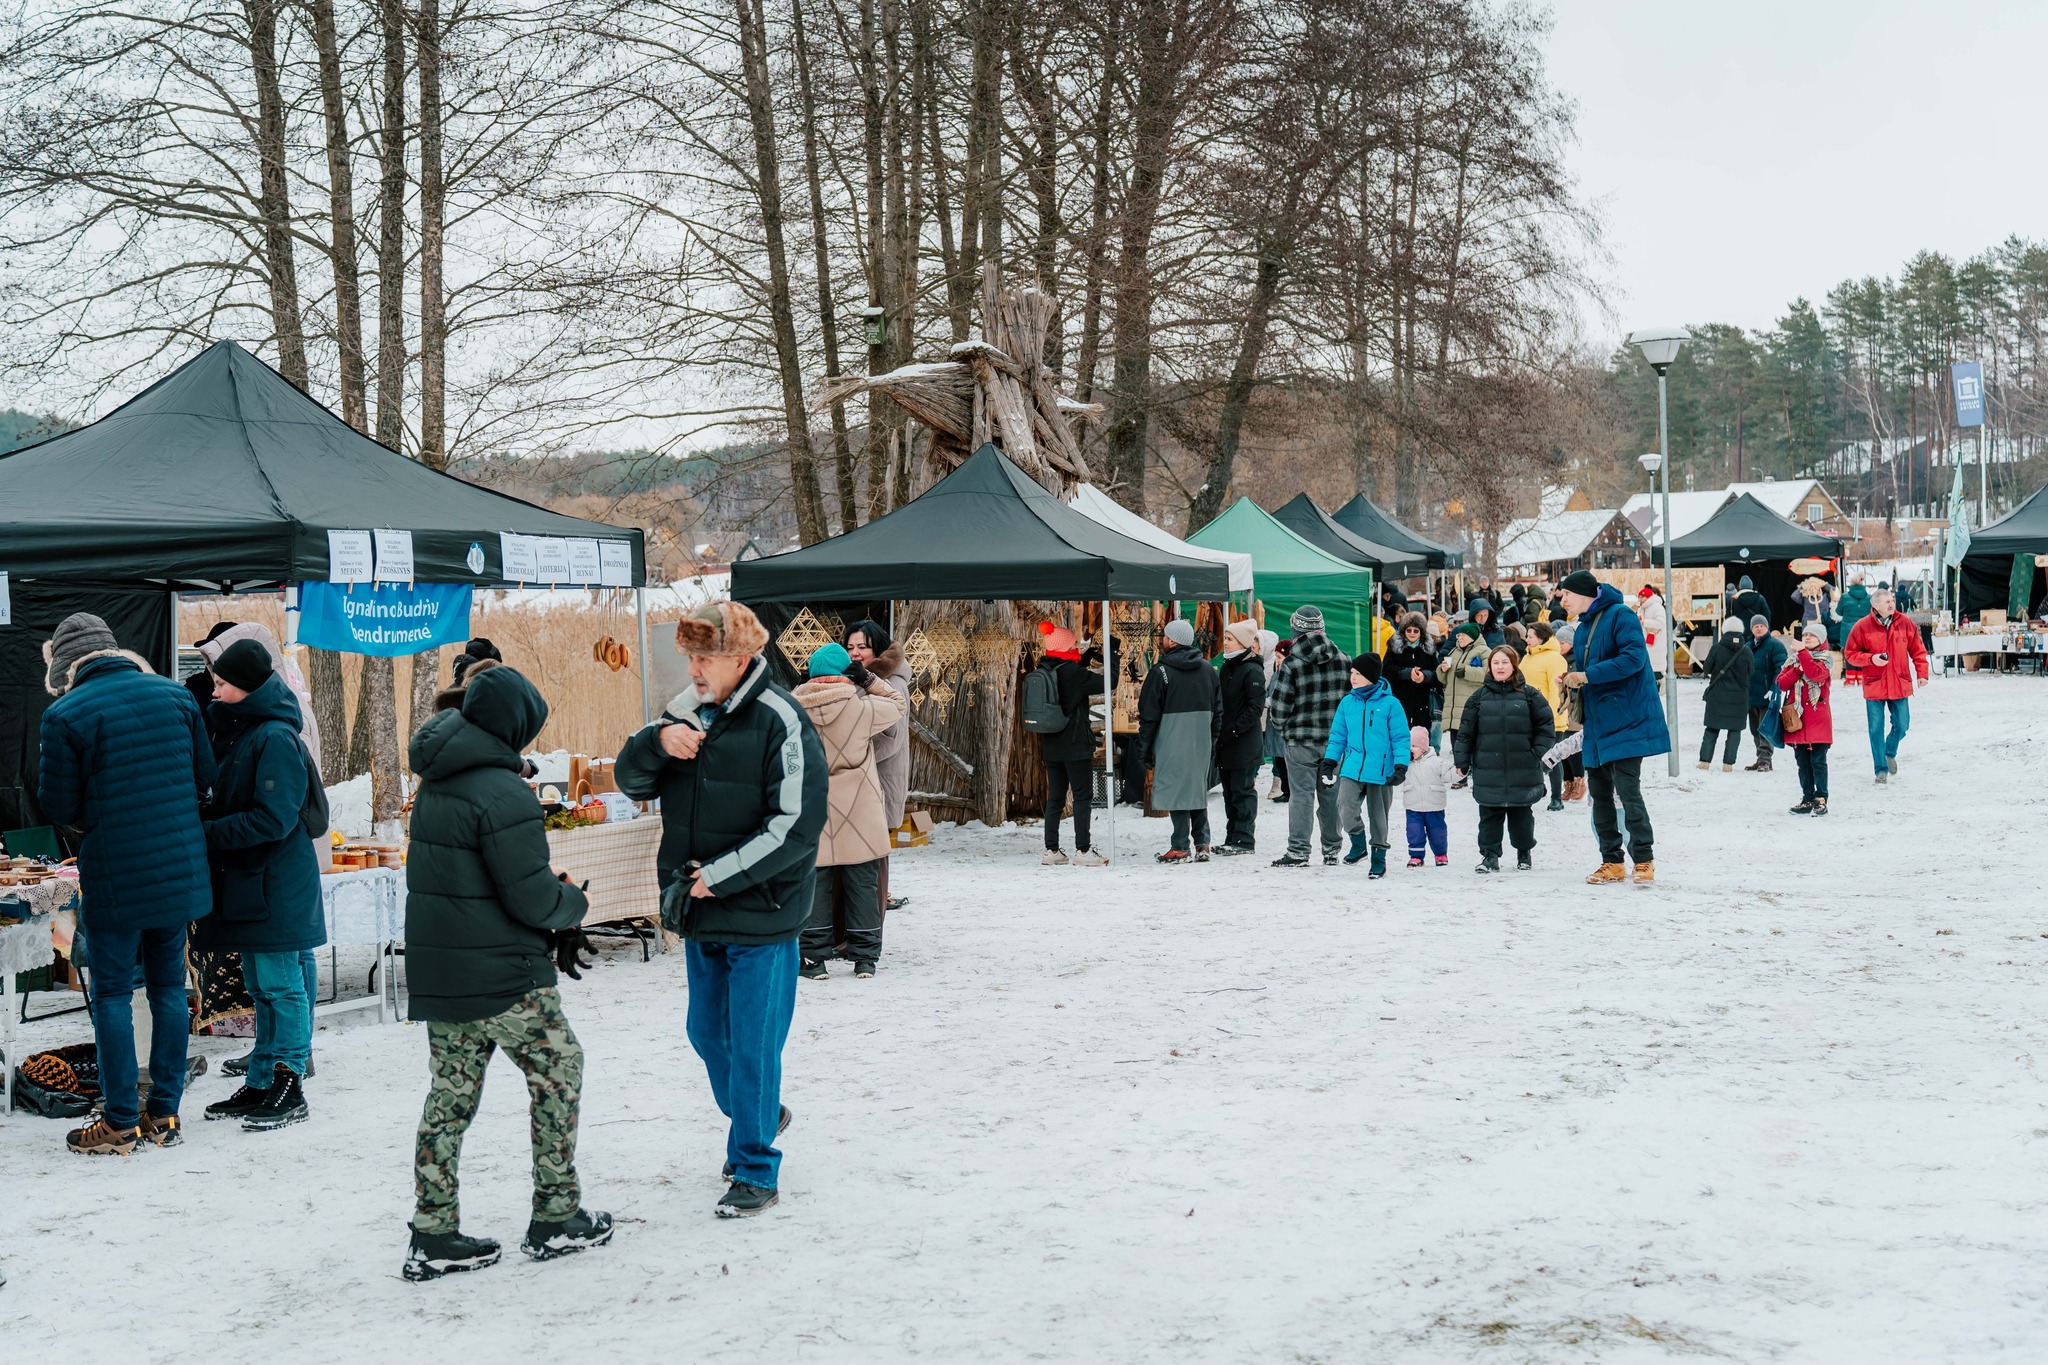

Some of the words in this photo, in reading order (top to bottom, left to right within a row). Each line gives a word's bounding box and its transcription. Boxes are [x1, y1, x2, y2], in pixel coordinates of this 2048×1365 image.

[340, 567, 363, 576] MEDUS
[379, 565, 411, 576] TROŠKINYS
[505, 566, 535, 576] MEDUOLIAI
[539, 565, 567, 573] LOTERIJA
[785, 742, 800, 775] FILA
